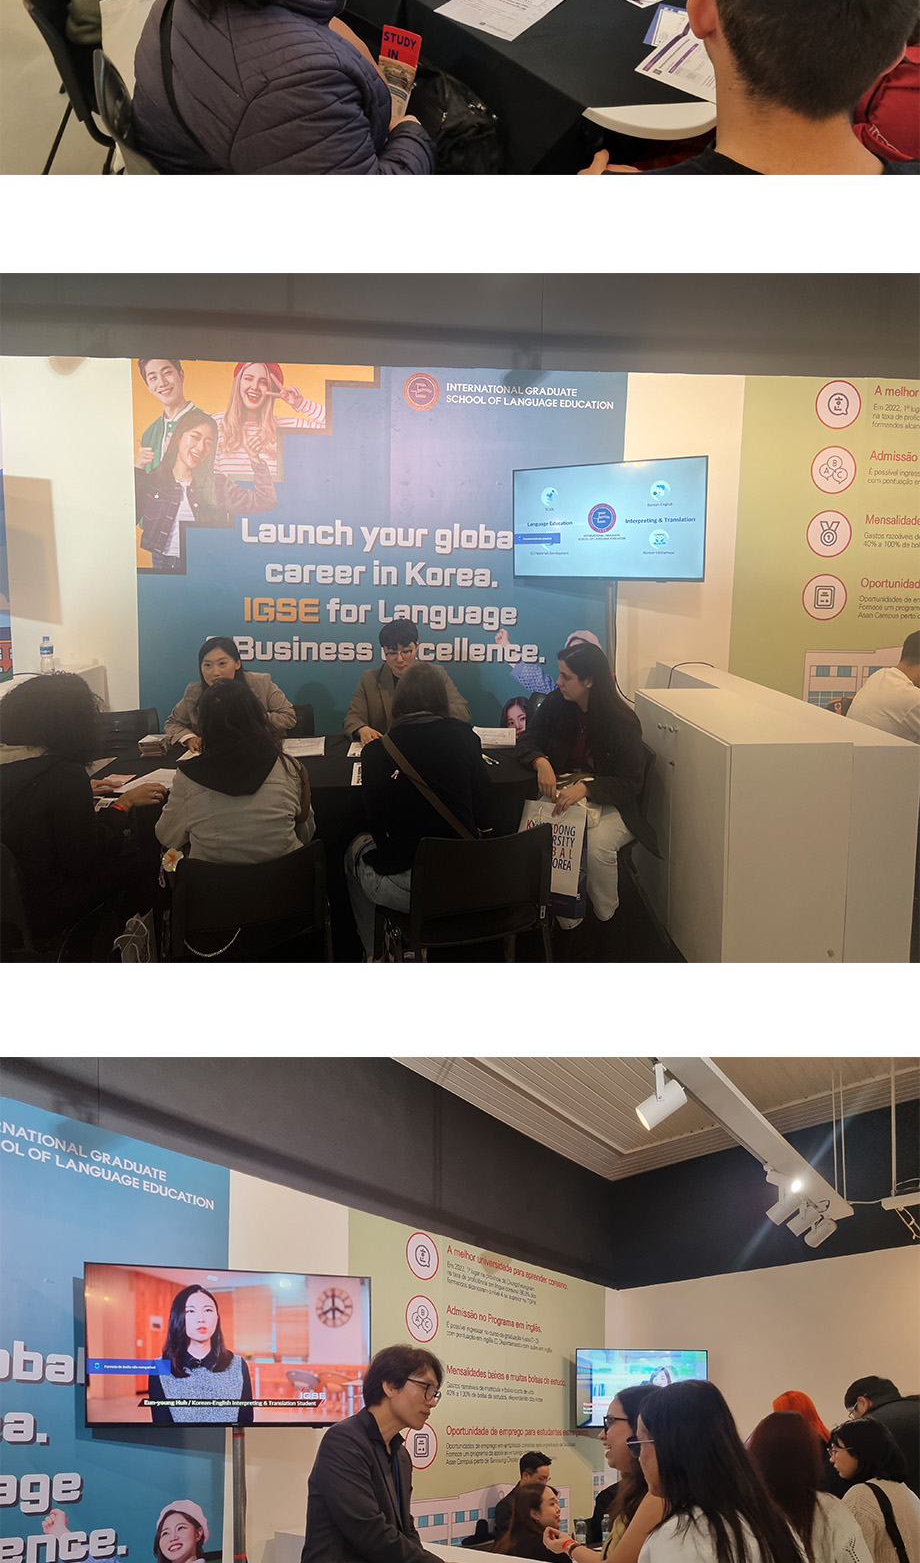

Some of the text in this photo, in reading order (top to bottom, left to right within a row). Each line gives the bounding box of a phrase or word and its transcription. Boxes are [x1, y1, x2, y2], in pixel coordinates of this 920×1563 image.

[383, 31, 417, 50] STUDY
[388, 48, 399, 60] IN
[446, 383, 578, 397] INTERNATIONAL GRADUATE
[874, 385, 919, 398] A melhor
[446, 395, 614, 410] SCHOOL OF LANGUAGE EDUCATION
[869, 450, 918, 463] Admissão
[241, 518, 354, 547] Launch
[361, 525, 428, 553] your
[265, 560, 499, 589] career in Korea.
[243, 597, 518, 631] IGSE for Language
[381, 637, 545, 664] cellence.
[90, 1149, 167, 1182] GRADUATE
[27, 1147, 215, 1210] OF LANGUAGE EDUCATION
[453, 1248, 476, 1263] melhor
[446, 1304, 478, 1321] Admissão
[478, 1313, 487, 1322] no
[487, 1313, 515, 1328] Programa
[515, 1321, 525, 1330] em
[144, 1399, 175, 1408] Eun-young
[175, 1399, 188, 1407] Huh
[191, 1400, 232, 1408] Korean-English
[232, 1400, 263, 1408] Interpreting
[268, 1400, 297, 1408] Translation
[446, 1425, 489, 1437] Oportunidade
[490, 1427, 498, 1436] de
[499, 1428, 524, 1437] emprego
